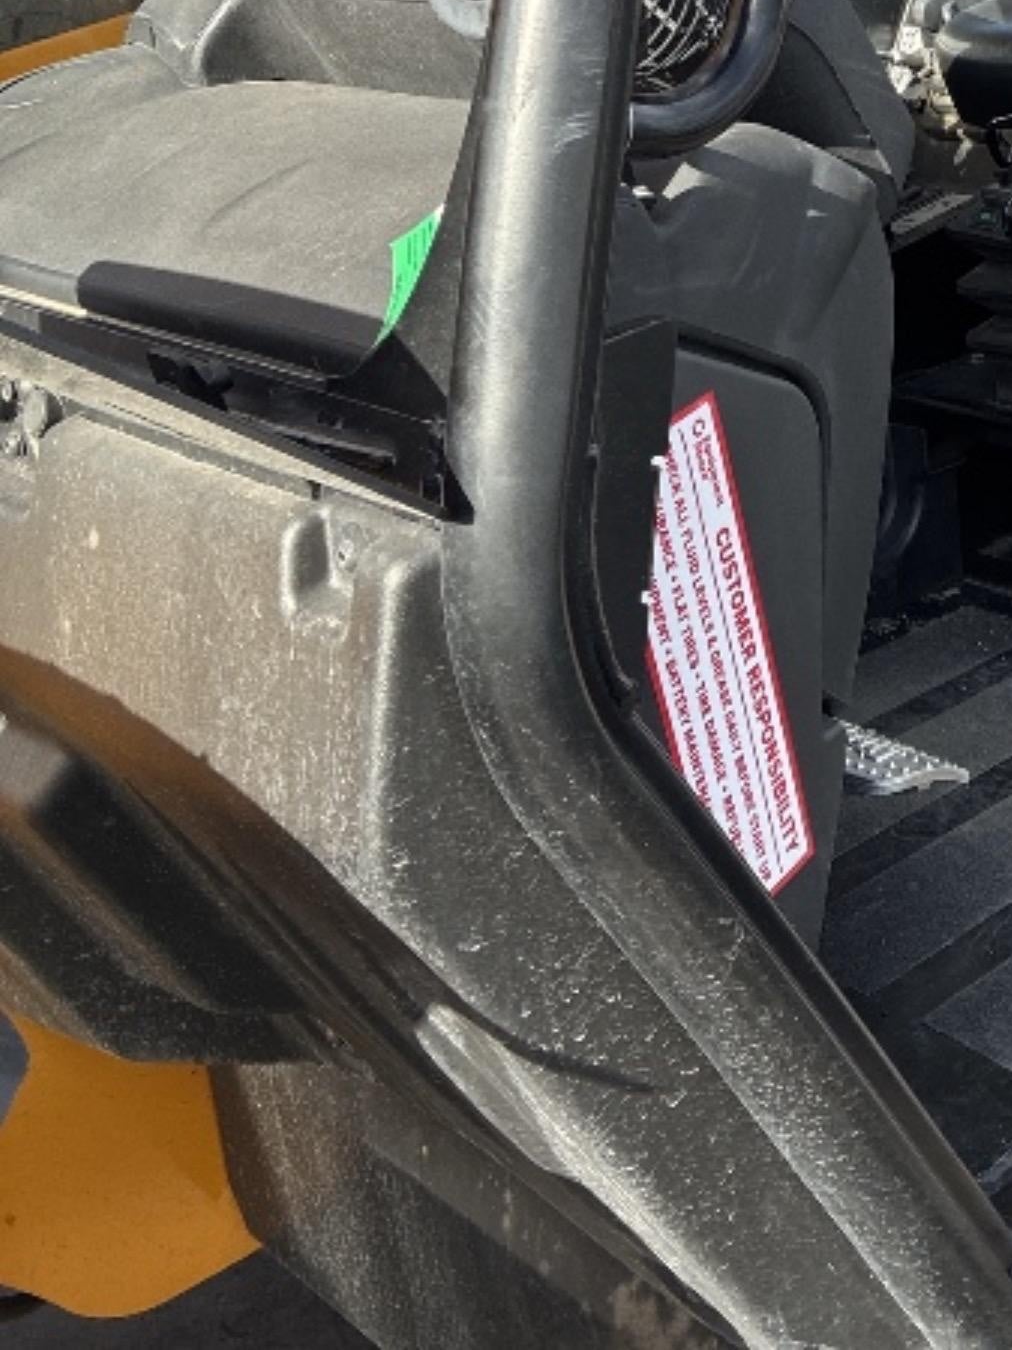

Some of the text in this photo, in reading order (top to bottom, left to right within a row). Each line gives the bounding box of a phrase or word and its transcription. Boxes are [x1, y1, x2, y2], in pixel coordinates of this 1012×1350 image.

[671, 583, 690, 623] FLAT
[681, 624, 700, 670] TIRES
[704, 719, 727, 785] DAMAGE
[680, 528, 700, 575] FLUID
[692, 576, 715, 635] LEVELS
[710, 649, 733, 710] GREASE
[725, 711, 742, 753] DAILY
[734, 753, 756, 813] BEFORE
[749, 813, 767, 858] START
[716, 527, 799, 853] CUSTOMER RESPONSIBILITY
